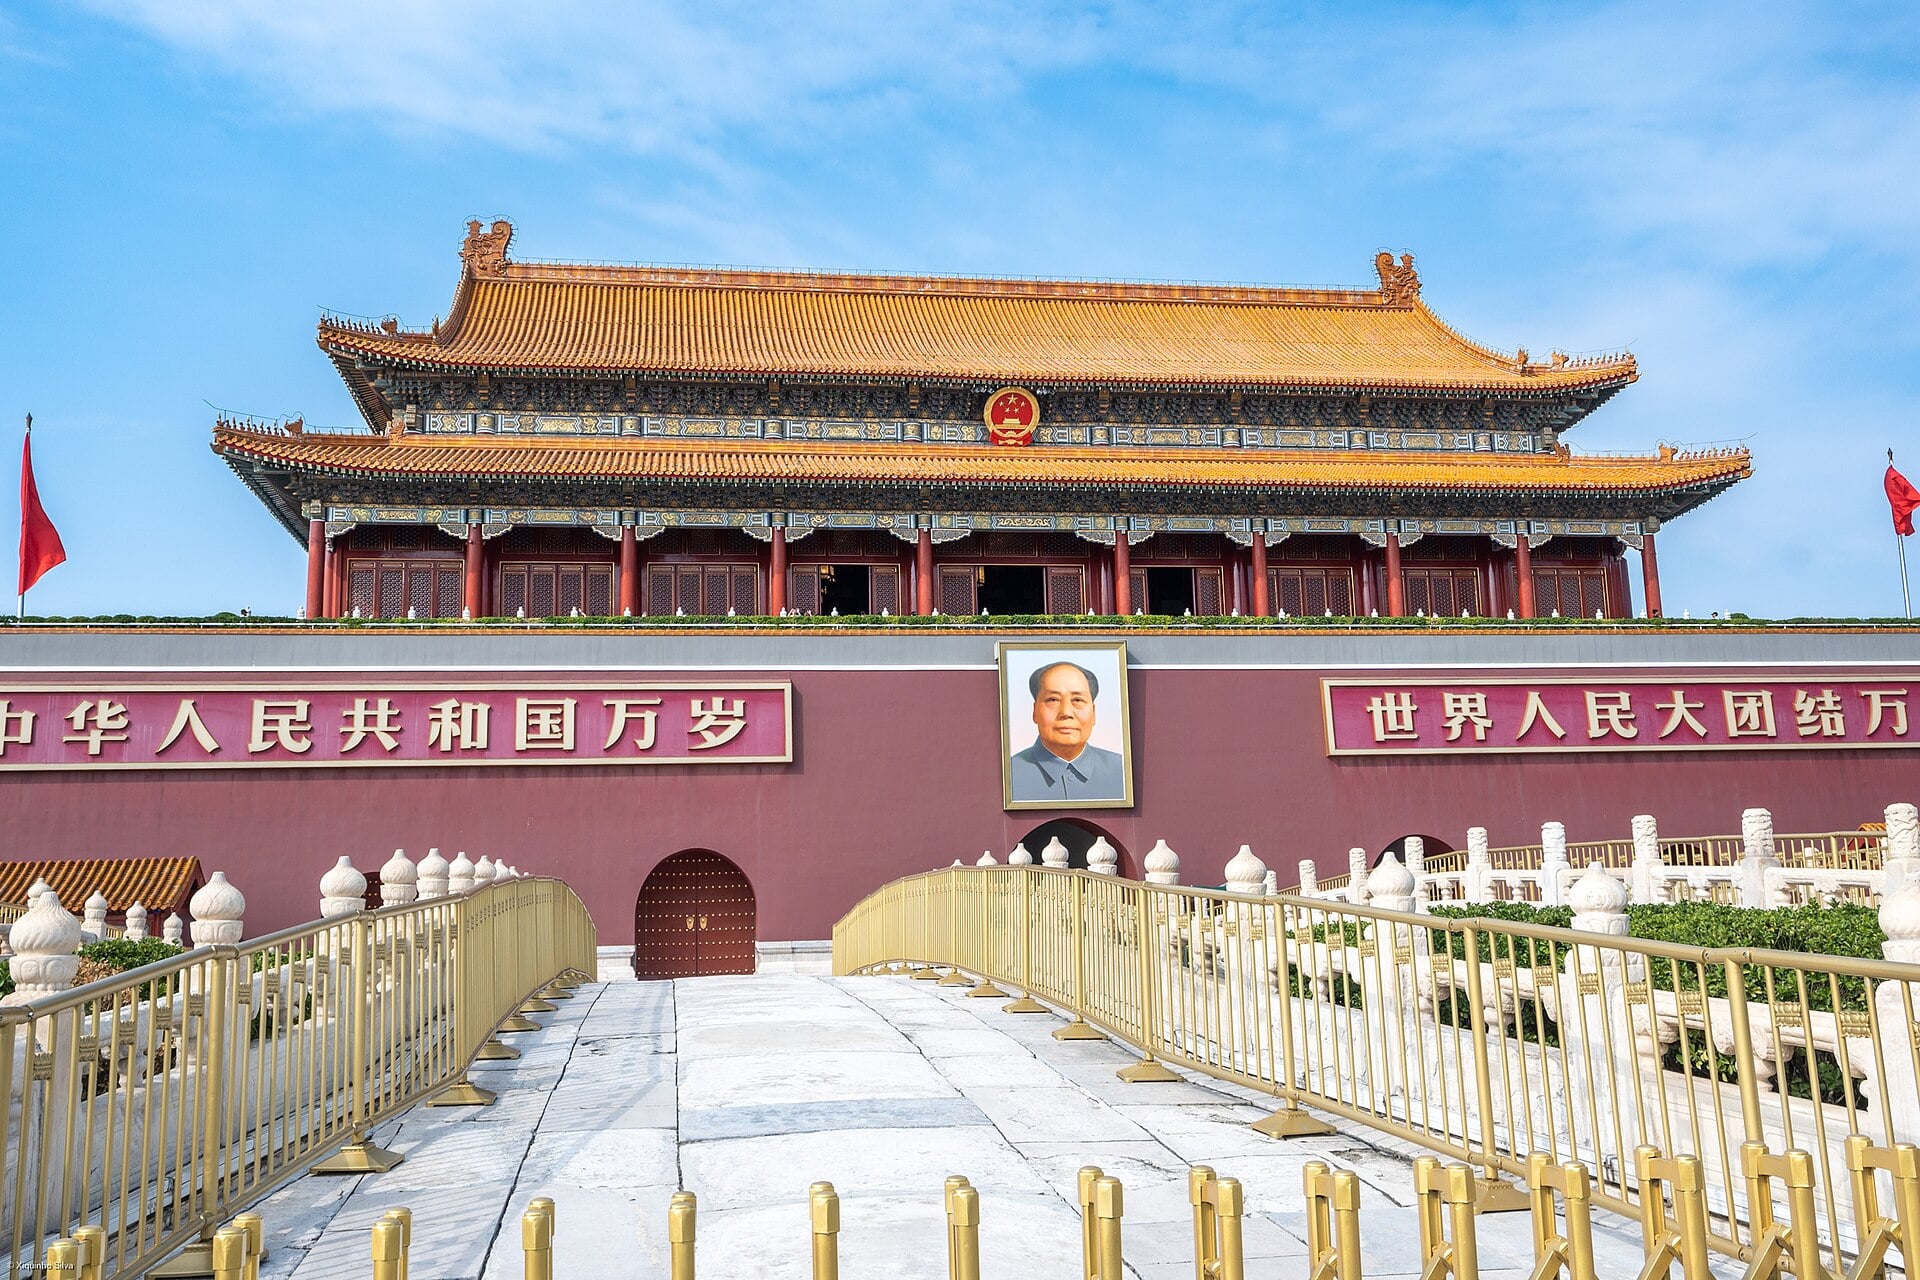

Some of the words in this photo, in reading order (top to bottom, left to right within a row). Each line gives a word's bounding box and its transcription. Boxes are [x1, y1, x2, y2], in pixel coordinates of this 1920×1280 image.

[1366, 688, 1908, 742] 世界人民大团结万
